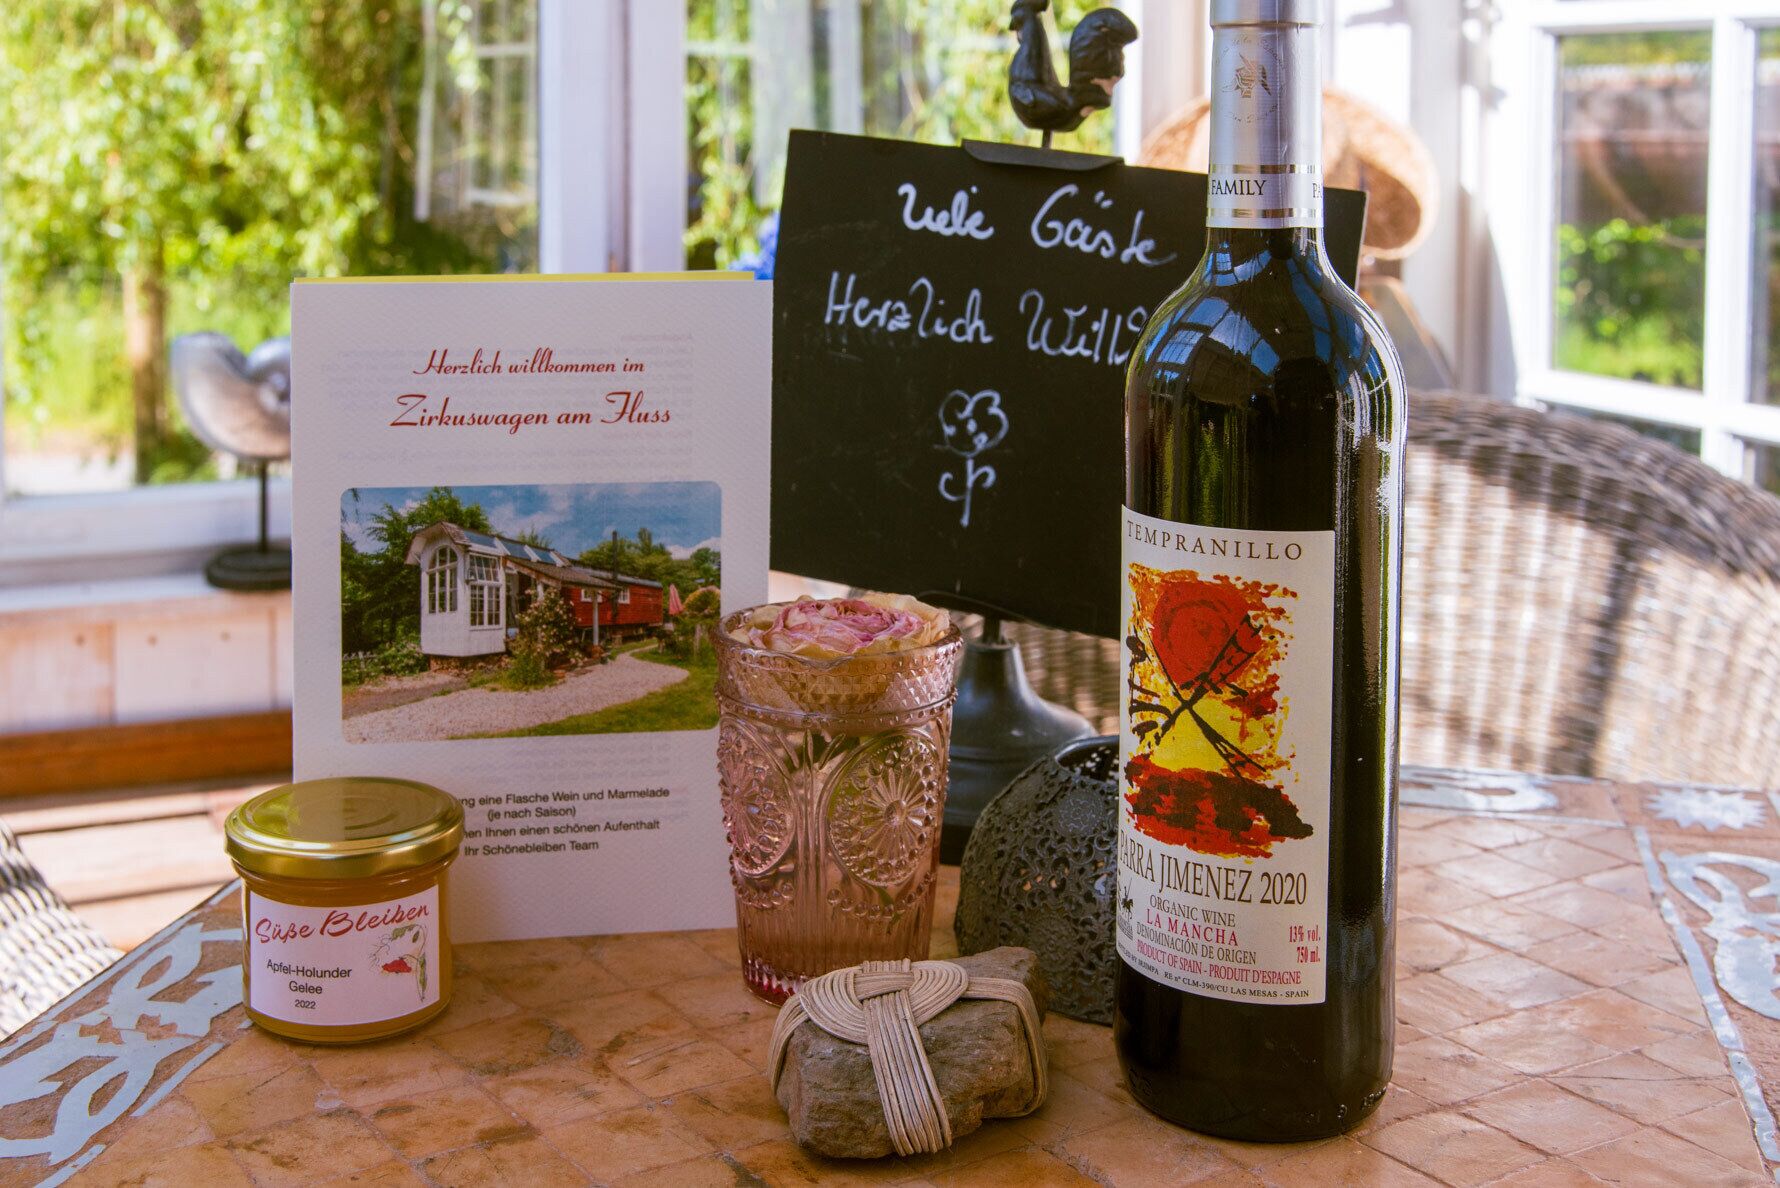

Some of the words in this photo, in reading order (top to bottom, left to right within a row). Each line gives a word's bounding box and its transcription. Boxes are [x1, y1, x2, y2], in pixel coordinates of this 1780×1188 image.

[1211, 179, 1267, 196] FAMILY
[1030, 183, 1178, 267] Gäste
[824, 271, 994, 344] Herzlich
[412, 347, 502, 376] Herzlich
[508, 347, 617, 374] willkommen
[622, 357, 646, 374] im
[389, 394, 549, 435] Zirkuswagen
[556, 411, 592, 426] am
[600, 391, 671, 425] Fluss
[1127, 519, 1302, 561] TEMPRANILLO
[478, 795, 503, 806] eine
[505, 792, 550, 804] Flasche
[552, 788, 580, 803] Wein
[582, 789, 604, 801] und
[607, 787, 670, 801] Marmelade
[487, 809, 501, 822] (je
[504, 807, 532, 819] nach
[534, 805, 577, 819] Saison)
[485, 826, 517, 838] Ihnen
[519, 825, 550, 837] einen
[552, 822, 601, 836] schönen
[603, 820, 660, 833] Aufenthalt
[463, 845, 480, 856] Ihr
[482, 841, 568, 857] Schönebleiben
[569, 839, 600, 852] Team
[1119, 829, 1156, 883] PARRA
[1158, 853, 1253, 905] JIMENEZ
[1259, 871, 1308, 905] 2020
[1149, 894, 1198, 921] ORGANIC
[1201, 908, 1236, 928] WINE
[255, 918, 315, 944] Süße
[319, 904, 430, 937] Bleiben
[1146, 908, 1162, 929] LA
[1167, 917, 1239, 947] MANCHA
[1288, 925, 1304, 943] 13%
[1307, 924, 1321, 942] vol.
[1136, 921, 1199, 957] DENOMINACIÓN
[1201, 944, 1214, 960] DE
[1216, 947, 1257, 965] ORIGEN
[1296, 946, 1309, 964] 750
[1310, 946, 1321, 963] ml.
[266, 958, 353, 979] Apfel-Holunder
[1136, 938, 1167, 965] PRODUCT
[1167, 953, 1179, 969] OF
[1179, 956, 1202, 975] SPAIN
[1208, 963, 1251, 984] PRODUIT
[1252, 970, 1302, 985] D'ESPAGNE
[288, 980, 324, 995] Gelee
[1182, 977, 1229, 993] CLM-390/CU
[1230, 986, 1247, 996] LAS
[1248, 988, 1278, 998] MESAS
[1285, 989, 1310, 998] SPAIN
[294, 999, 317, 1010] 2022
